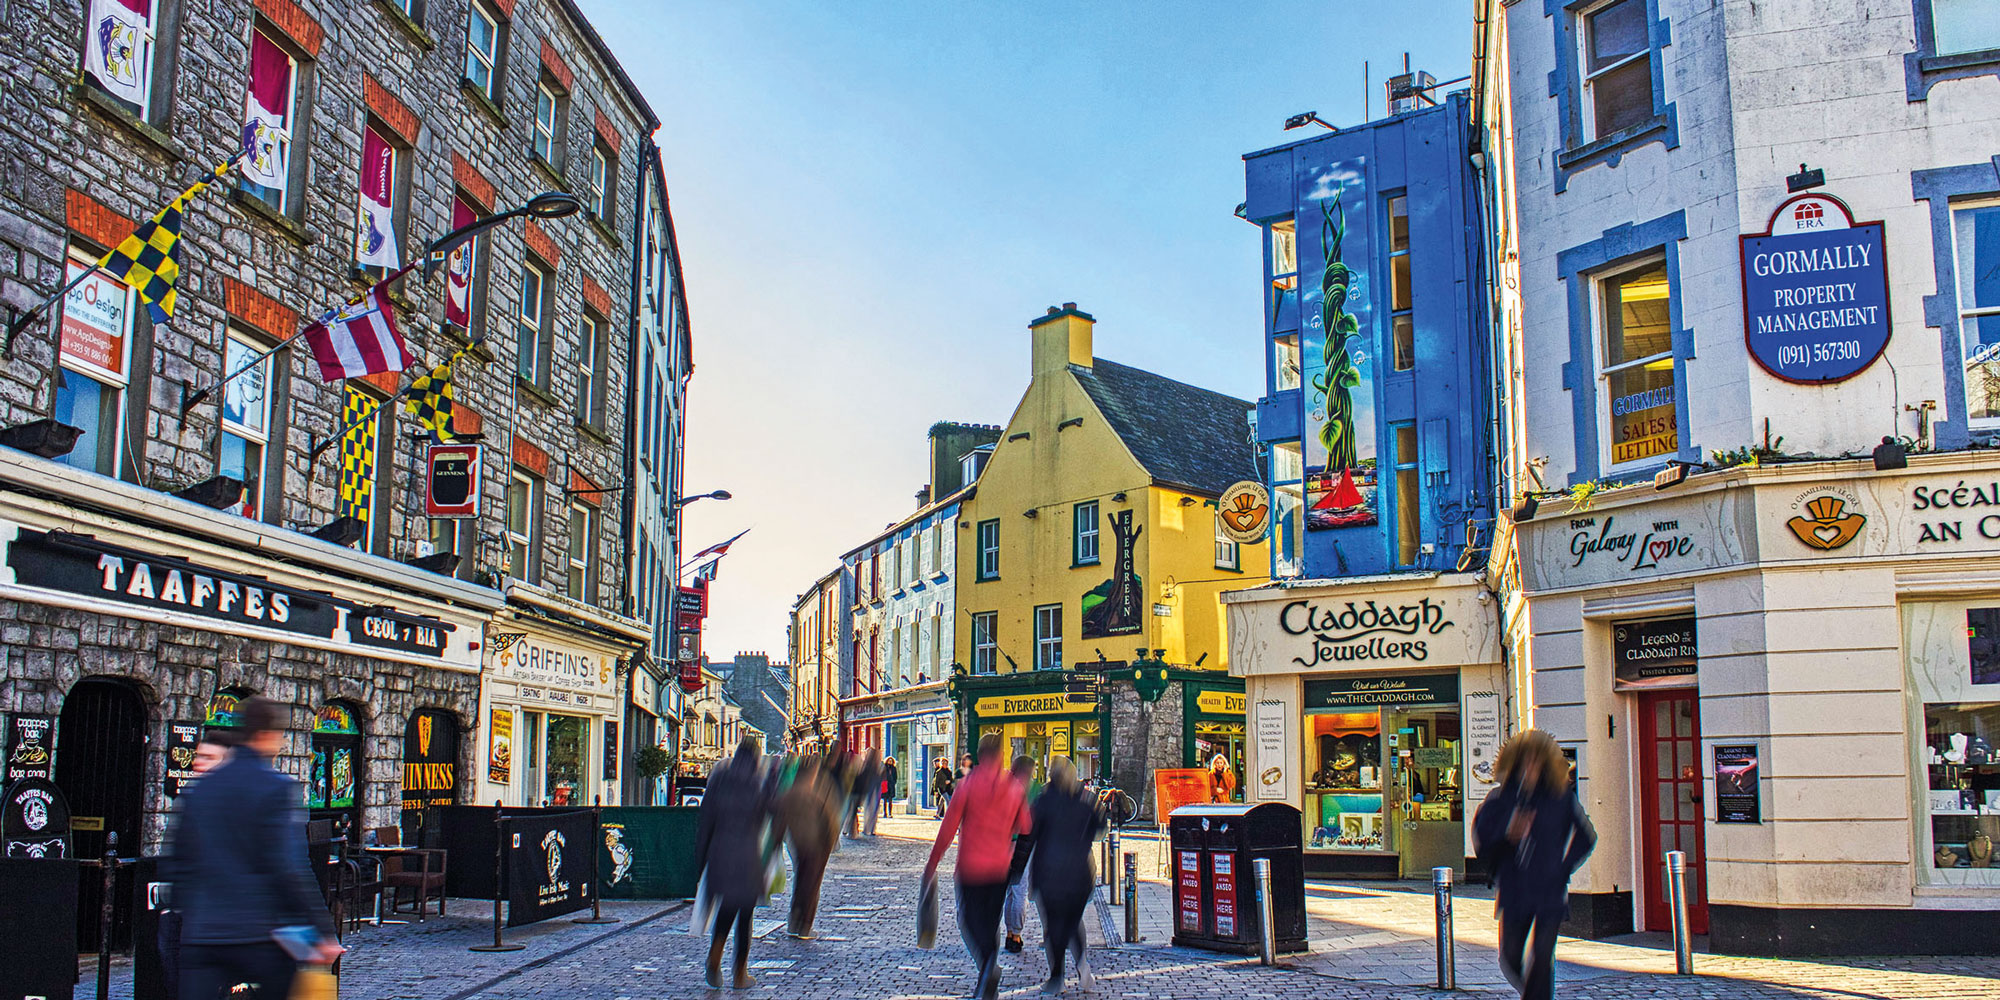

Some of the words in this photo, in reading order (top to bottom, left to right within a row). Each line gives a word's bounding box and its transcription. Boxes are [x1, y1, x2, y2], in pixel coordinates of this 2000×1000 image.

[1796, 219, 1824, 230] ERA
[1753, 243, 1871, 277] GORMALLY
[1773, 282, 1857, 308] PROPERTY
[1757, 305, 1878, 334] MANAGEMENT
[1778, 343, 1811, 370] (091)
[1813, 339, 1861, 363] 567300
[1613, 385, 1677, 416] GORMALL
[1622, 416, 1666, 441] SALES
[1617, 433, 1679, 461] LETTING
[1570, 518, 1595, 529] FROM
[1652, 520, 1679, 531] WITH
[1918, 521, 1962, 543] AN
[1570, 516, 1636, 567] Galway
[1123, 513, 1131, 617] EVERGREEN
[97, 553, 290, 623] TAAFFES
[362, 616, 399, 641] CEOL
[415, 626, 438, 648] BIA
[1641, 632, 1680, 646] LEGEND
[516, 640, 589, 678] GRIFFIN'S
[1626, 645, 1678, 661] CLADDAGH
[1641, 668, 1667, 676] VISITOR
[1668, 666, 1693, 674] CENTRE
[522, 687, 541, 699] SEATING
[1201, 698, 1221, 706] HEALTH
[980, 703, 999, 711] HEALTH
[1003, 696, 1064, 714] EVERGREEN
[401, 762, 454, 790] UINNESS
[1183, 879, 1198, 888] ANSEO
[1216, 883, 1232, 891] ANSEO
[1183, 900, 1198, 909] HERE
[1217, 904, 1232, 914] HERE
